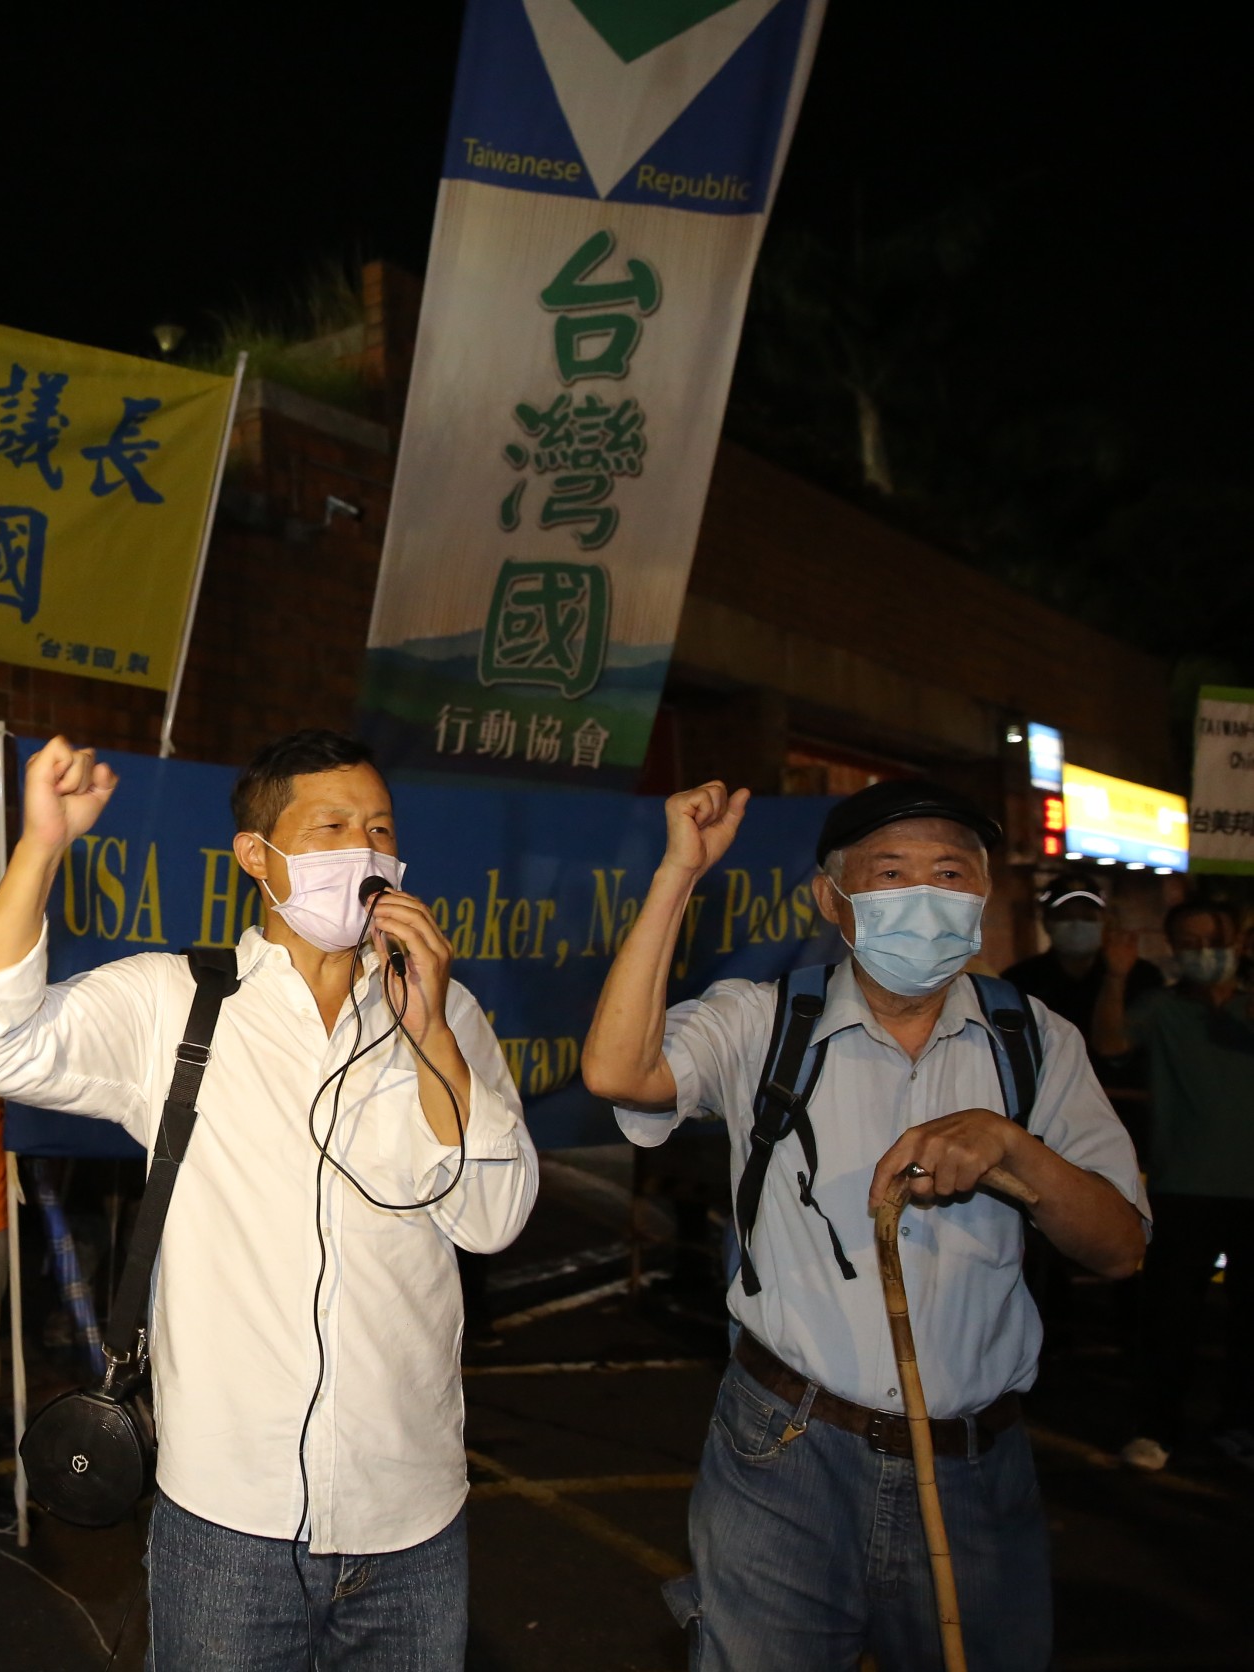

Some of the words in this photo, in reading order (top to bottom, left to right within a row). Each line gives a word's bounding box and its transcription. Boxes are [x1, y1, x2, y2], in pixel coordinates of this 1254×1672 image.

[463, 138, 582, 182] Taiwanese
[637, 165, 752, 201] Republic
[477, 228, 662, 700] 台灣國
[434, 703, 611, 769] 行動協會
[61, 834, 168, 945] USA
